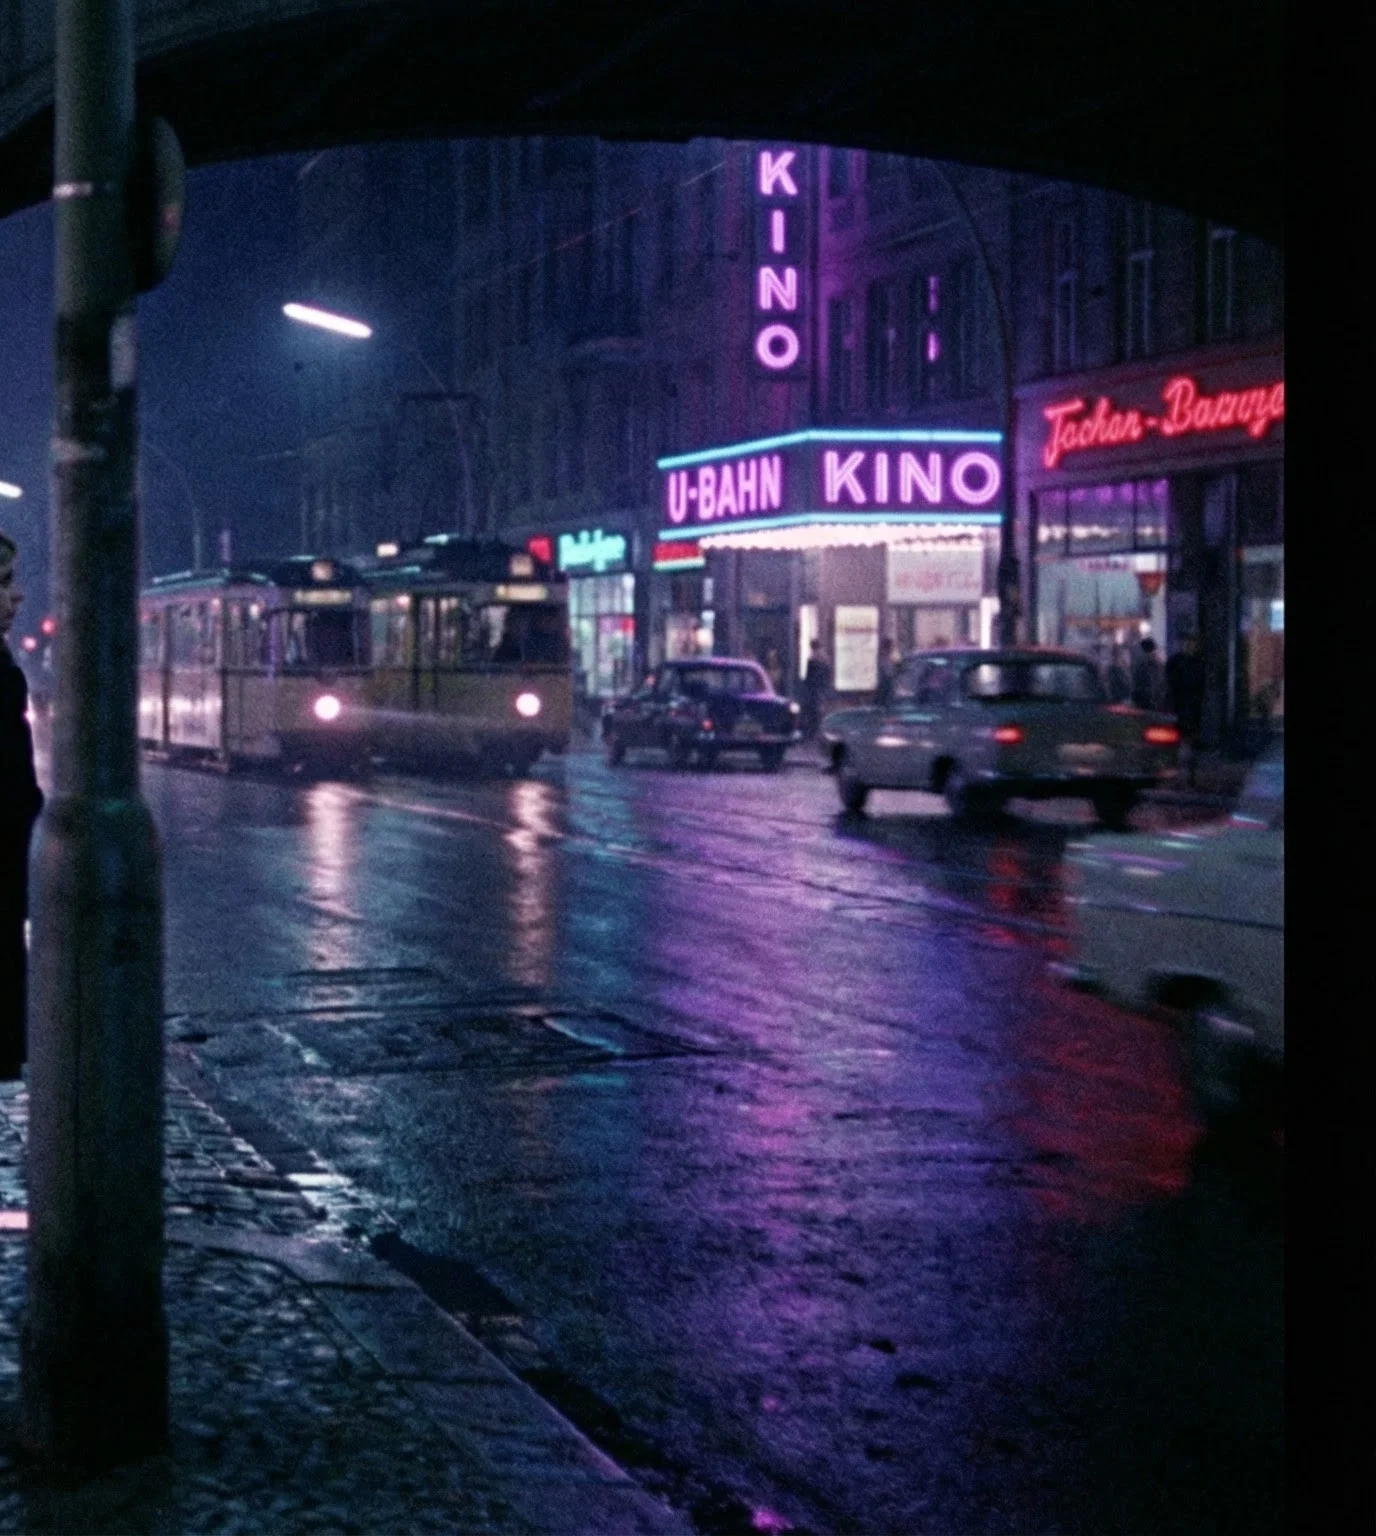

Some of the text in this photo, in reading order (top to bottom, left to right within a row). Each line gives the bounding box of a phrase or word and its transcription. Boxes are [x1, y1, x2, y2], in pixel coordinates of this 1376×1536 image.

[756, 151, 800, 369] KINO
[669, 455, 782, 524] U-BAHN
[825, 450, 1000, 505] KINO
